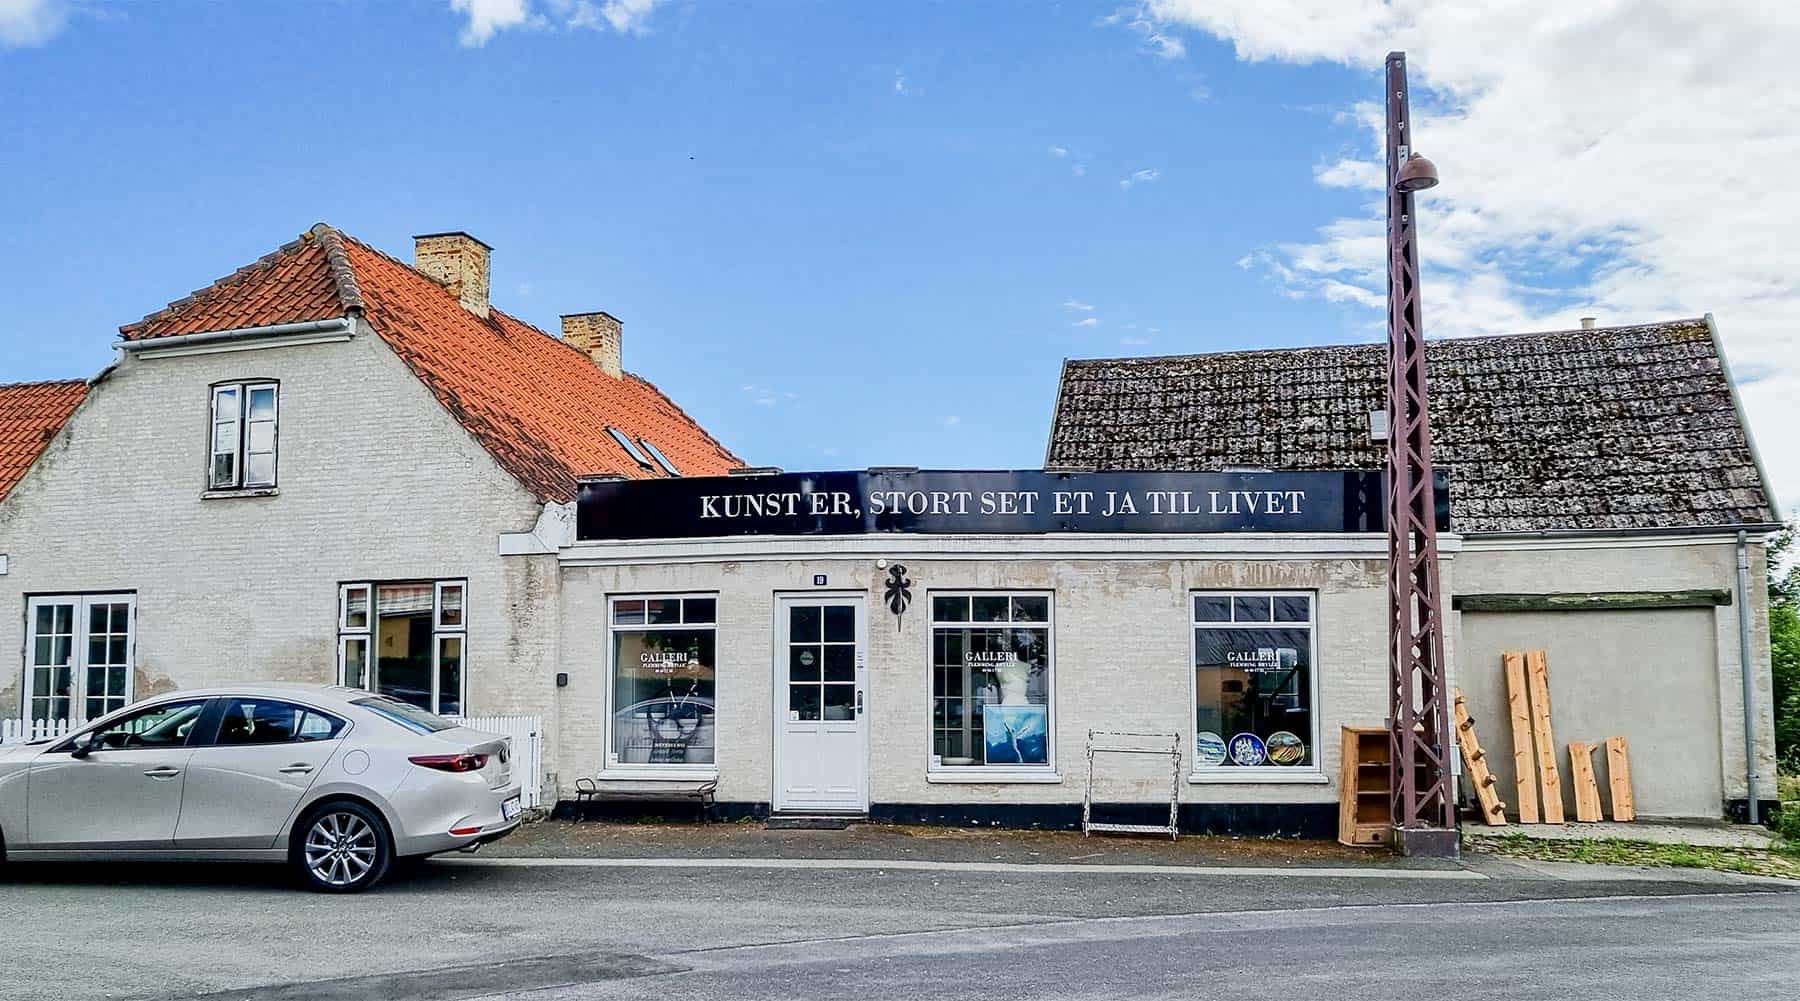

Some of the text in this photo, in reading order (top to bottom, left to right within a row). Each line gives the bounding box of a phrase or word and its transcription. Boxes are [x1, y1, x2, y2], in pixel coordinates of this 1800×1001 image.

[700, 491, 1306, 519] KUNST ER, STORT SET ET JA TIL LIVET
[640, 652, 688, 663] GALLERI
[965, 651, 1018, 662] GALLERI
[1227, 651, 1280, 662] GALLERI
